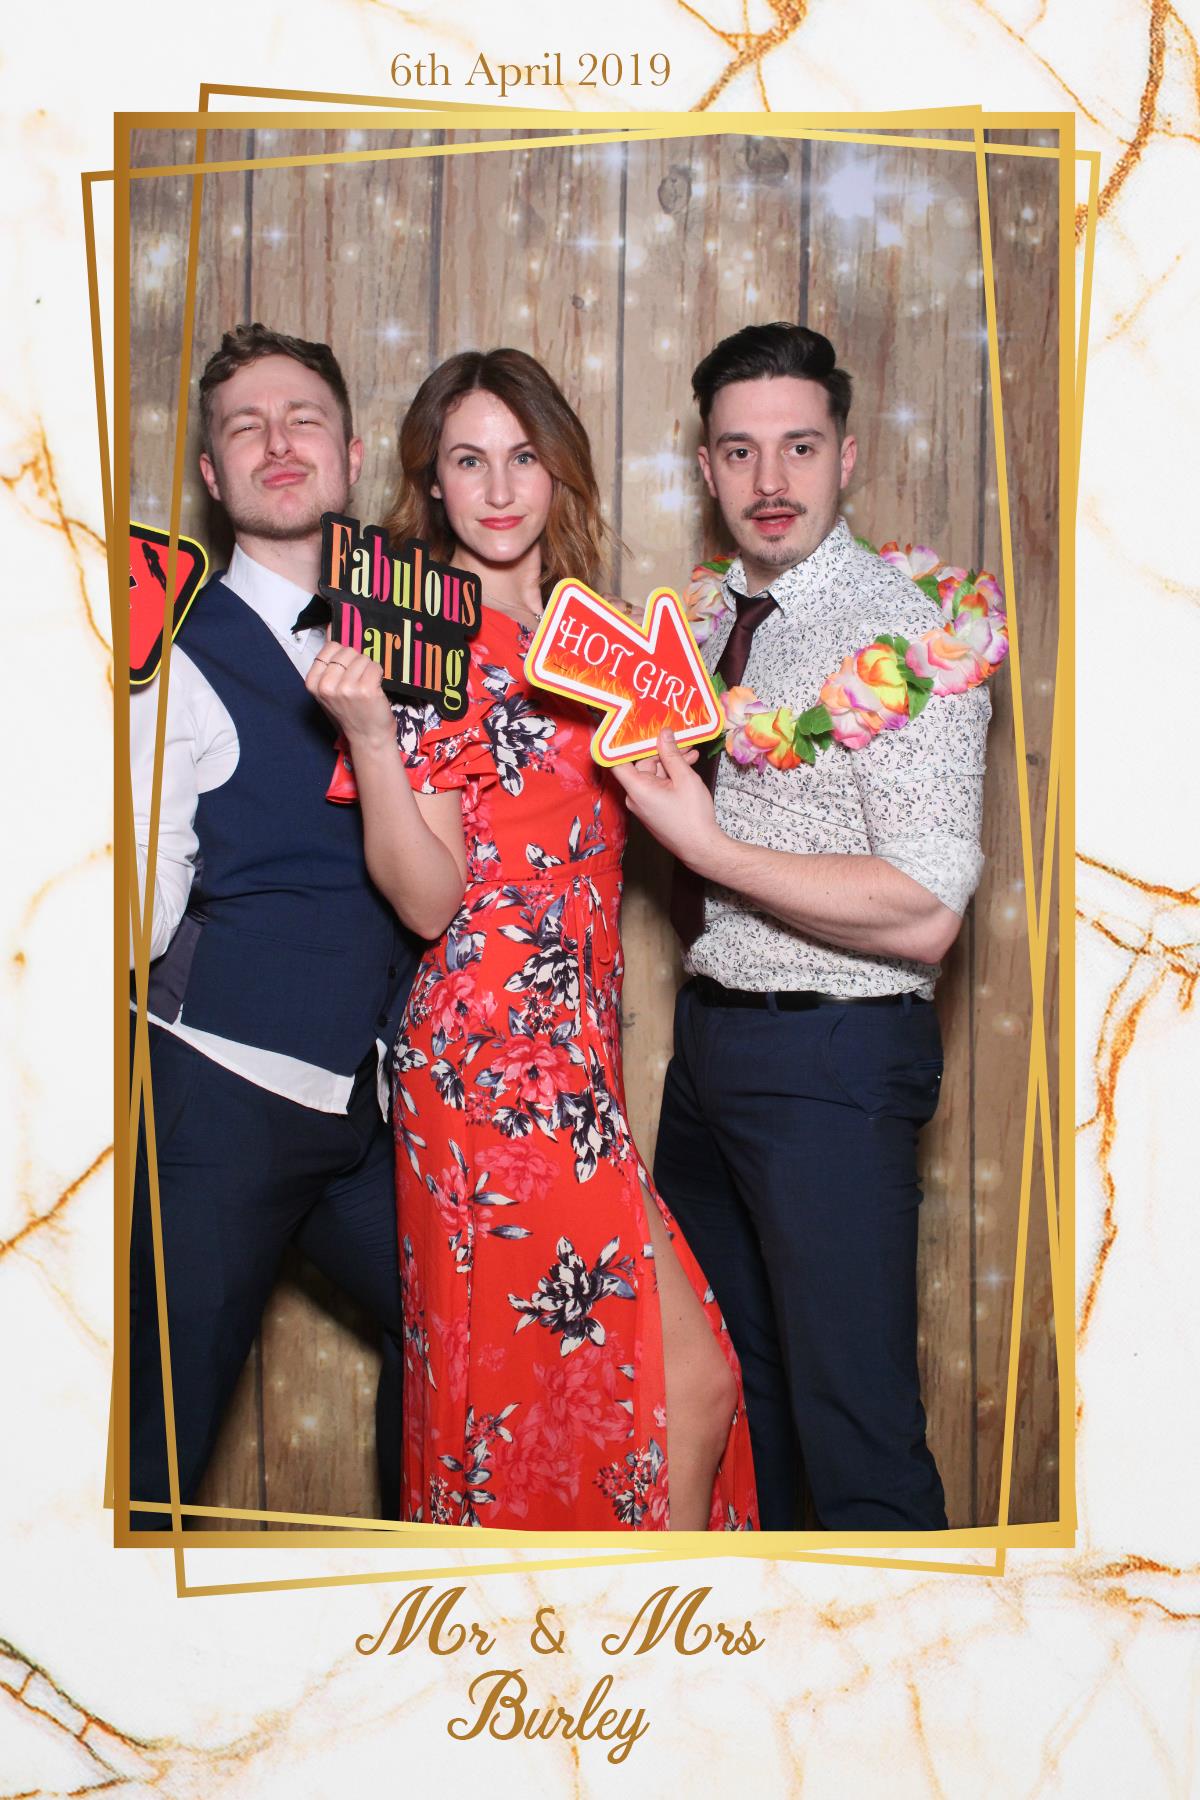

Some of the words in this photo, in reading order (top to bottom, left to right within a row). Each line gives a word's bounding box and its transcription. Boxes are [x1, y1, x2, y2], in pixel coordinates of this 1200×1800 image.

[328, 521, 476, 627] Fabulous
[340, 602, 465, 711] Darling
[557, 616, 634, 677] HOT
[633, 660, 697, 726] GIRL
